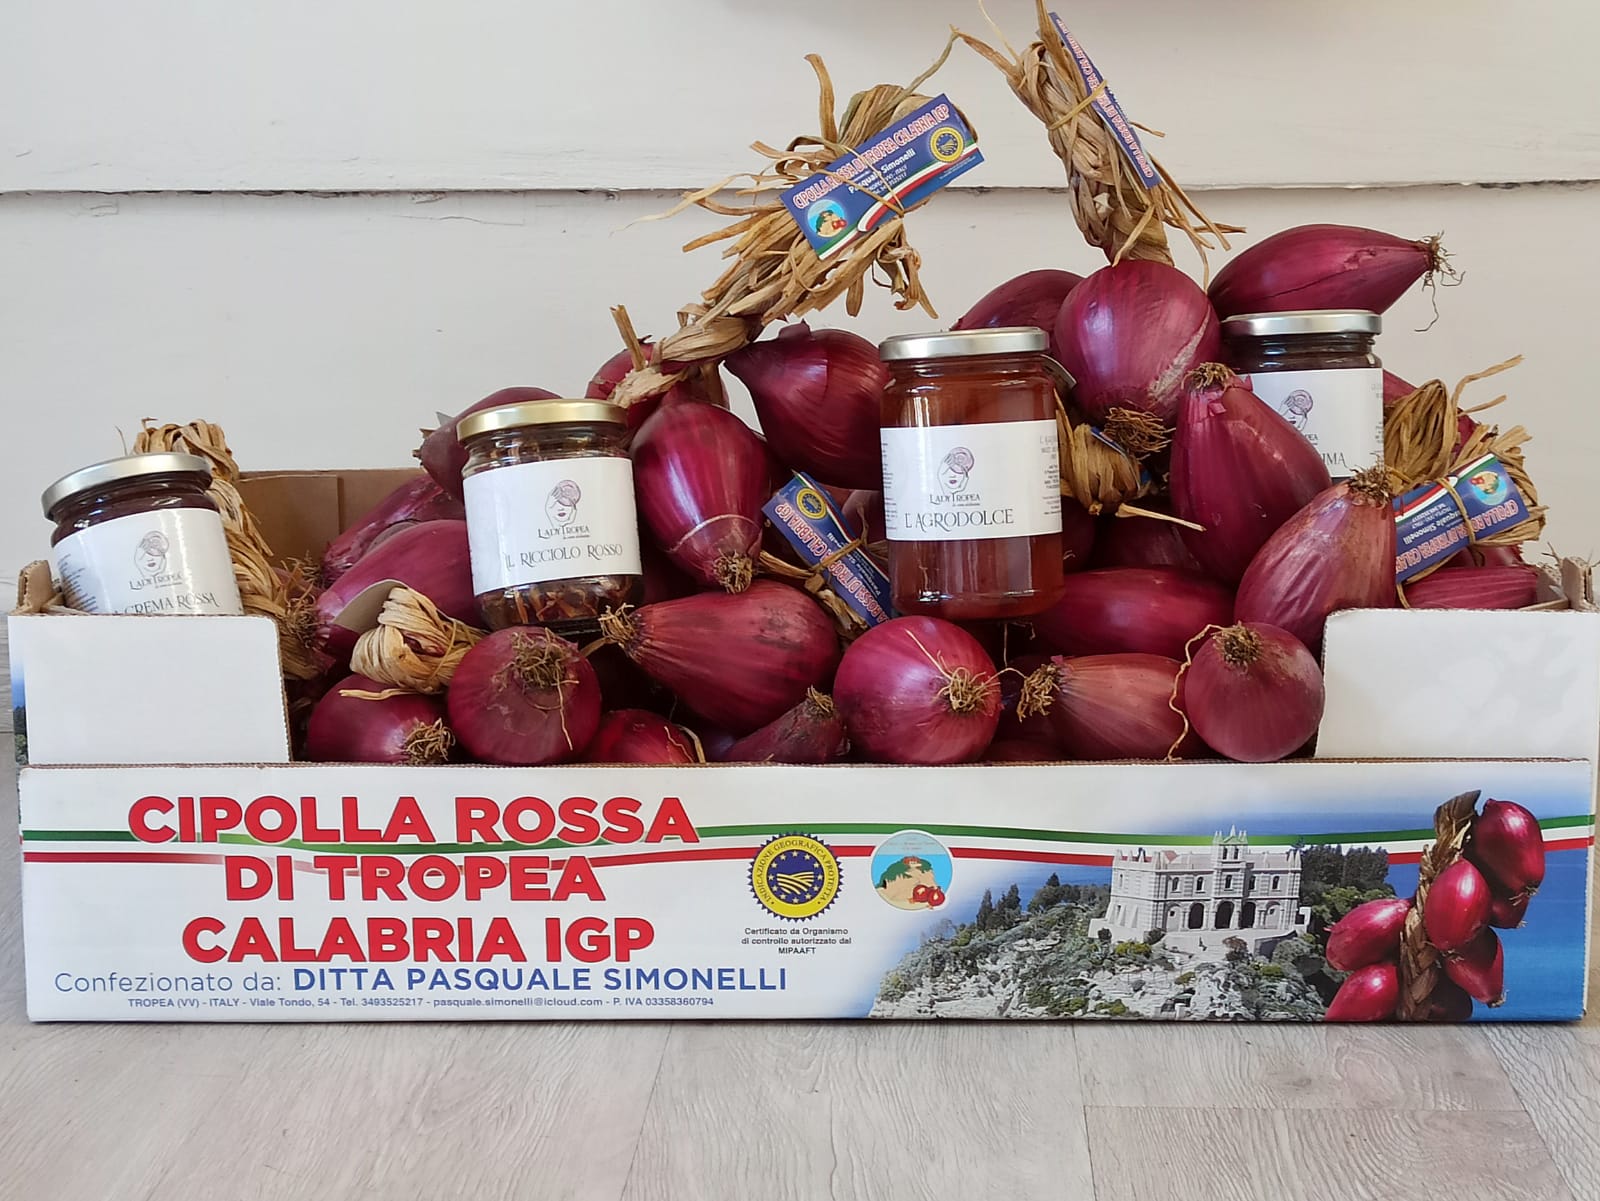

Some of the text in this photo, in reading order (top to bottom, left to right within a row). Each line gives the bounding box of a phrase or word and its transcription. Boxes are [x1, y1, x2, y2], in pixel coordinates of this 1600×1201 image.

[793, 180, 831, 208] CIPOLLA
[894, 113, 937, 145] CALABRIA
[931, 104, 949, 122] IGP
[881, 148, 915, 173] Simonelli
[775, 502, 795, 521] IGP
[788, 514, 827, 555] CALABRIA
[1403, 523, 1436, 544] Simonelli
[1456, 515, 1485, 538] ROSA
[520, 547, 581, 568] RICCIOLO
[587, 544, 623, 561] ROSSO
[821, 549, 854, 586] TROPA
[177, 592, 220, 610] ROSSA
[128, 795, 700, 844] CIPOLLA ROSSA
[224, 855, 607, 902] DI TROPEA
[182, 916, 655, 964] CALABRIA IGP
[741, 937, 852, 945] di controllo autorizzato dal
[744, 927, 788, 935] Certificato
[802, 928, 849, 937] Organismo
[778, 947, 817, 955] MIPAAFT
[54, 968, 787, 992] Confezionato da: DITTA PASQUALE SIMONELLI
[128, 998, 175, 1008] TROPEA
[177, 998, 200, 1009] (VV)
[209, 998, 240, 1008] ITALY
[249, 998, 276, 1008] Viale
[279, 998, 315, 1009] Tondo,
[317, 997, 331, 1007] 54
[341, 997, 359, 1007] Tel.
[361, 997, 424, 1007] 3493525217
[433, 997, 603, 1008] pasquale.simonelli@icloud.com
[613, 997, 623, 1007] P.
[625, 997, 643, 1007] IVA
[645, 997, 715, 1007] 03358360794
